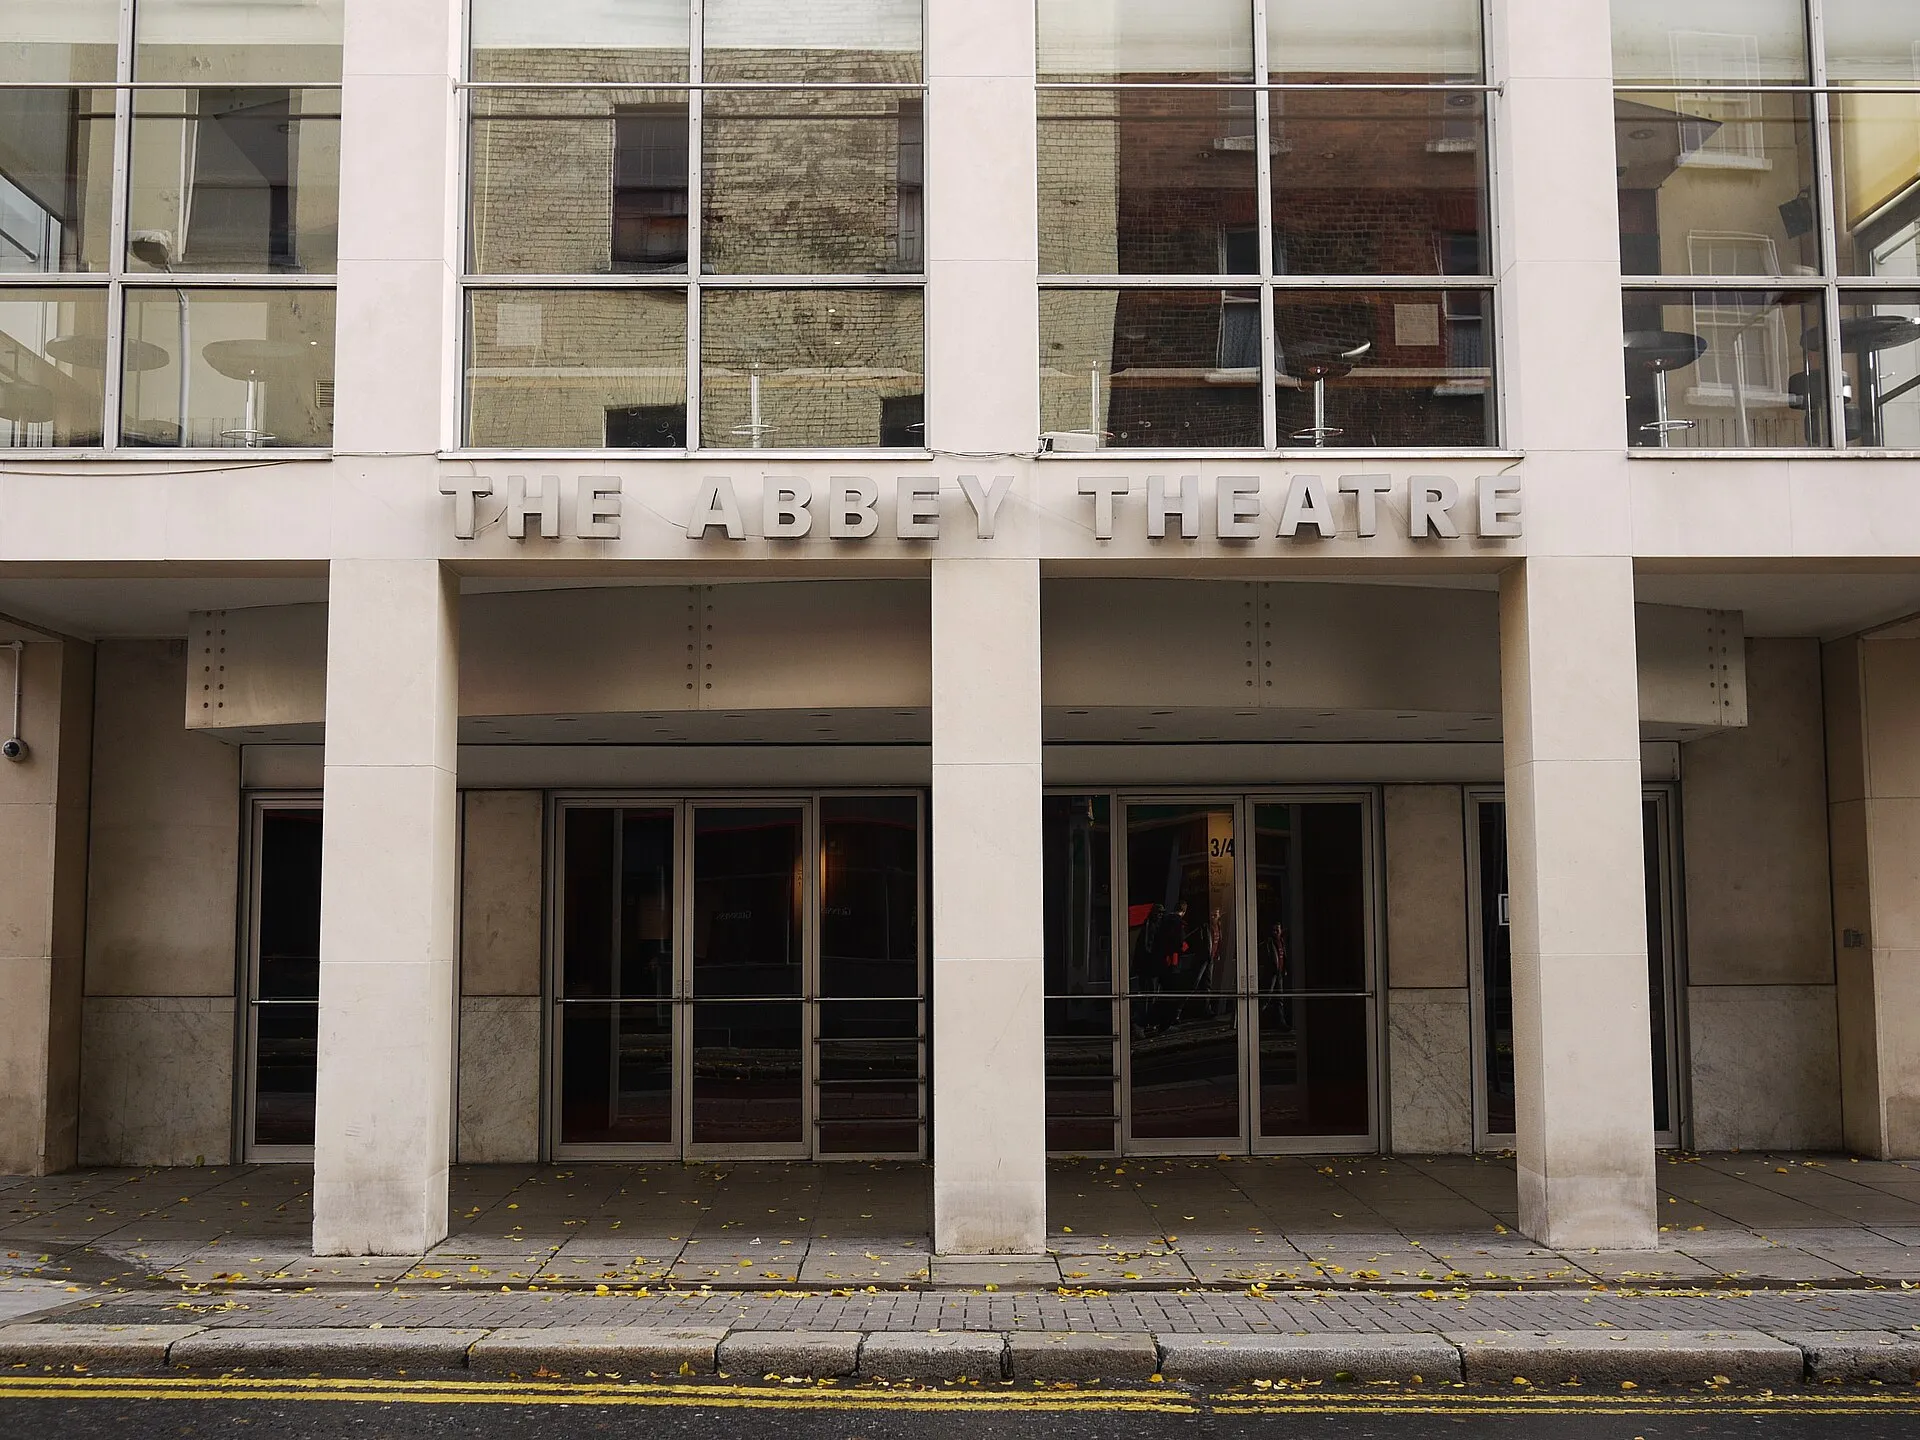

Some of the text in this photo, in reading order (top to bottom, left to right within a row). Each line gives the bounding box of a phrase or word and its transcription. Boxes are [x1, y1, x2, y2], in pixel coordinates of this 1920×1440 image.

[439, 474, 1522, 541] THE ABBEY THEATRE
[1210, 838, 1235, 858] 3/4
